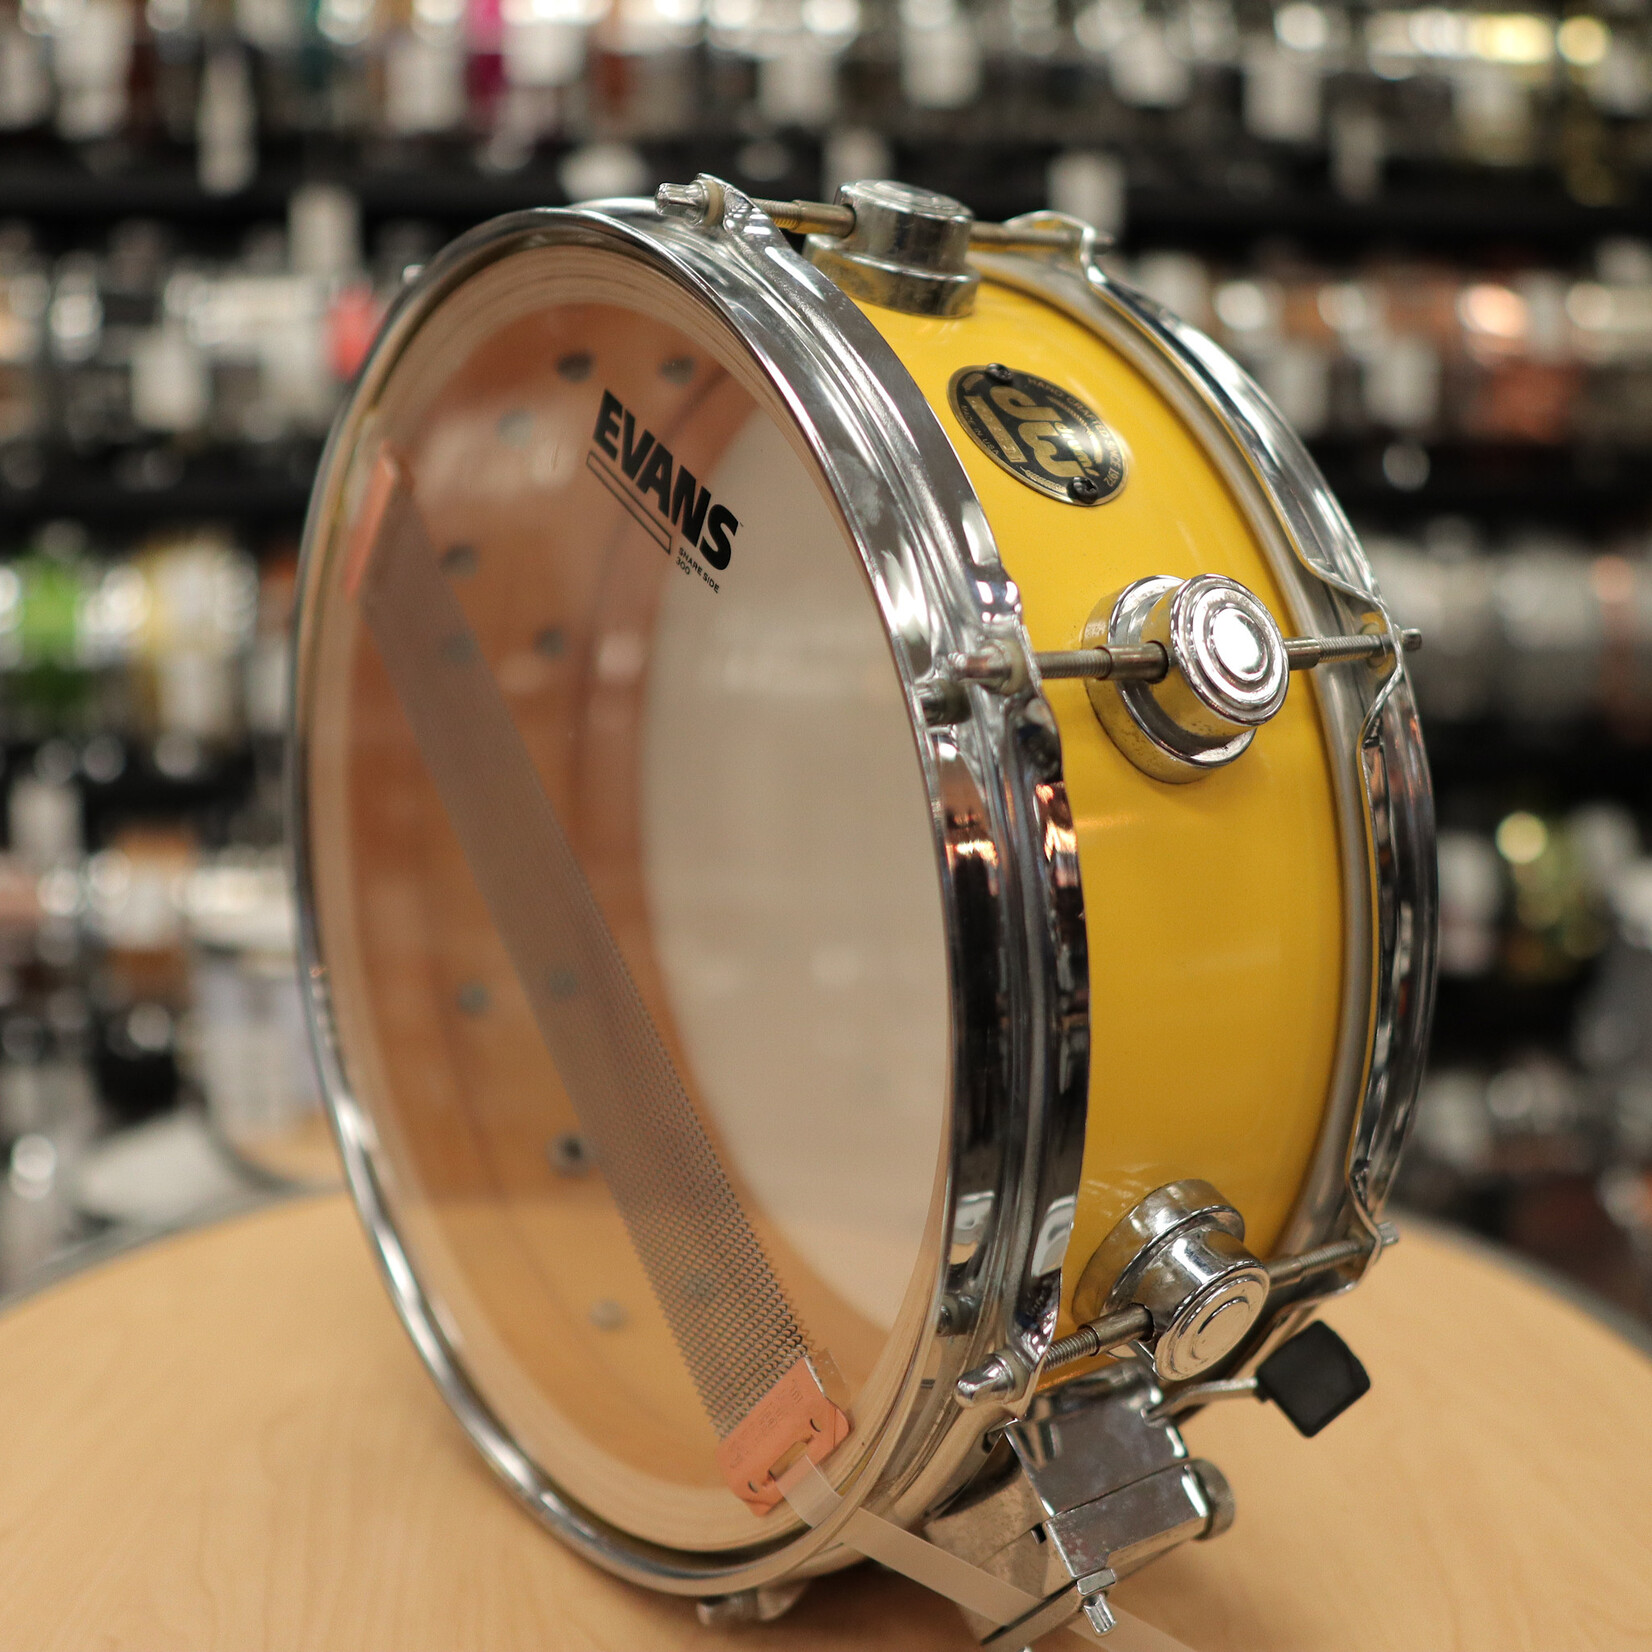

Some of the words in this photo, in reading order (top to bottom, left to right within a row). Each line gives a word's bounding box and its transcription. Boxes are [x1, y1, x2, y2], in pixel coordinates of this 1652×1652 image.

[593, 388, 738, 570] EVANS
[1103, 467, 1120, 487] 1972
[676, 556, 690, 575] 300
[679, 547, 703, 576] SNARE
[703, 573, 719, 594] SIDE
